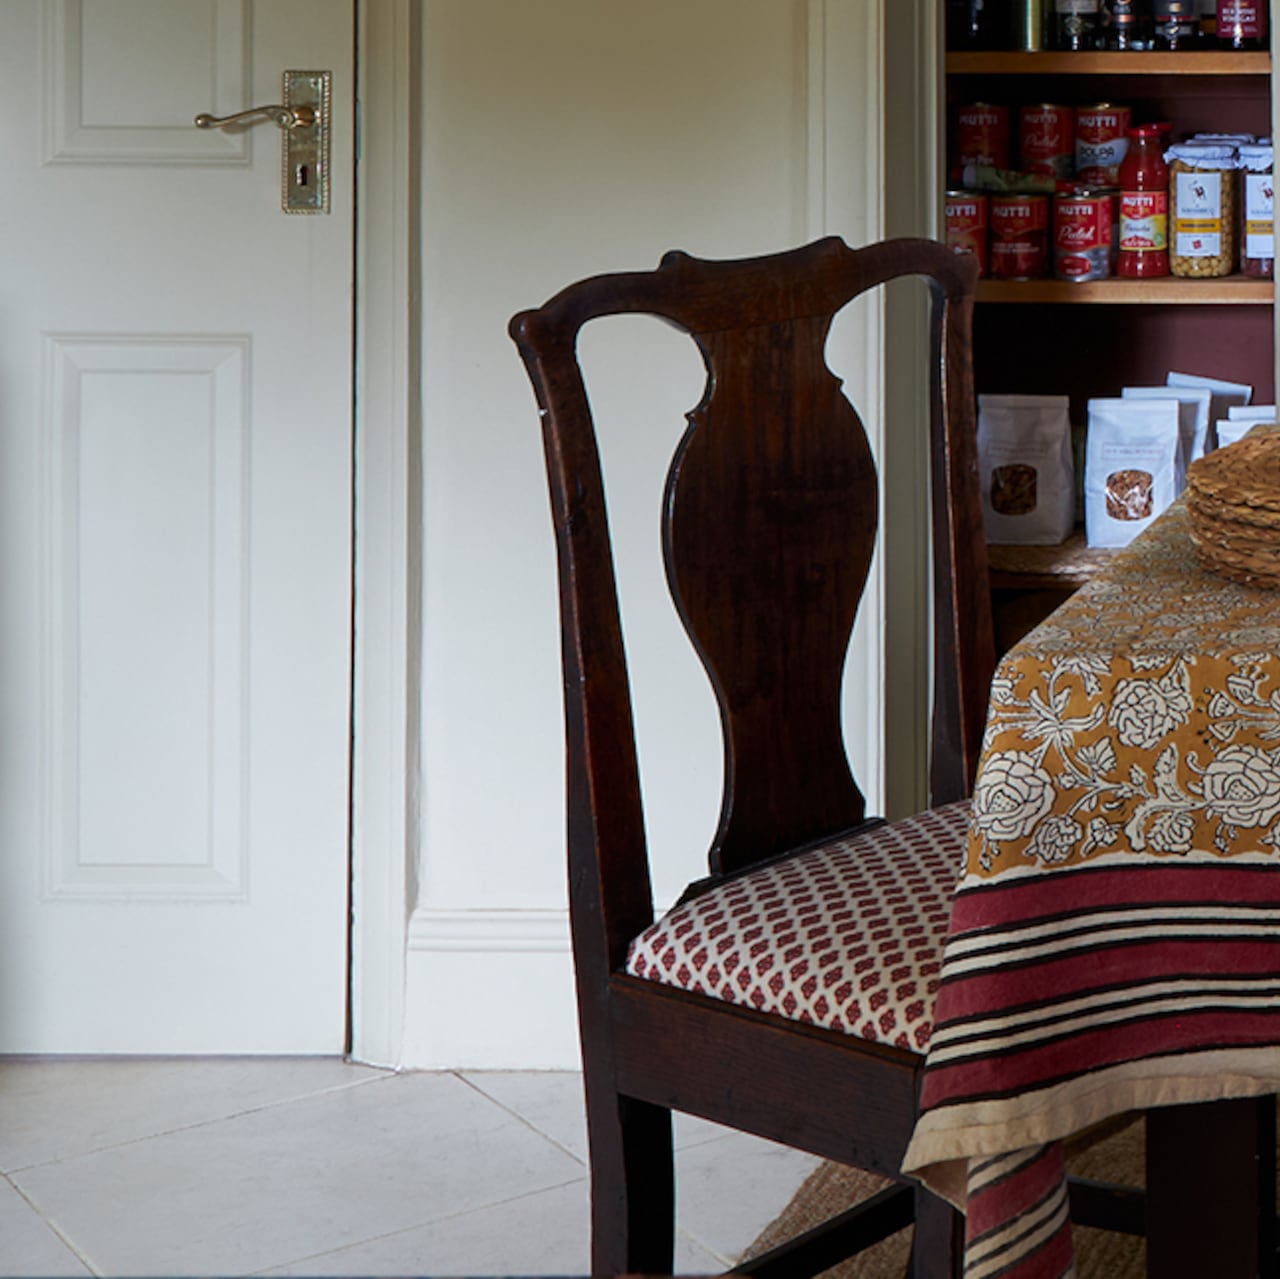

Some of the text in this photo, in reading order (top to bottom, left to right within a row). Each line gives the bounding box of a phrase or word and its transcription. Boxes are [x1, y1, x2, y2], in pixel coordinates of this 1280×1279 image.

[960, 112, 998, 126] MUTTI
[1024, 113, 1058, 124] MUTTI
[1078, 116, 1117, 128] MUTTI
[1080, 146, 1114, 157] POLPA
[1122, 196, 1154, 208] MUTTI
[992, 206, 1030, 218] MUTTI
[1058, 205, 1093, 216] MUTTI
